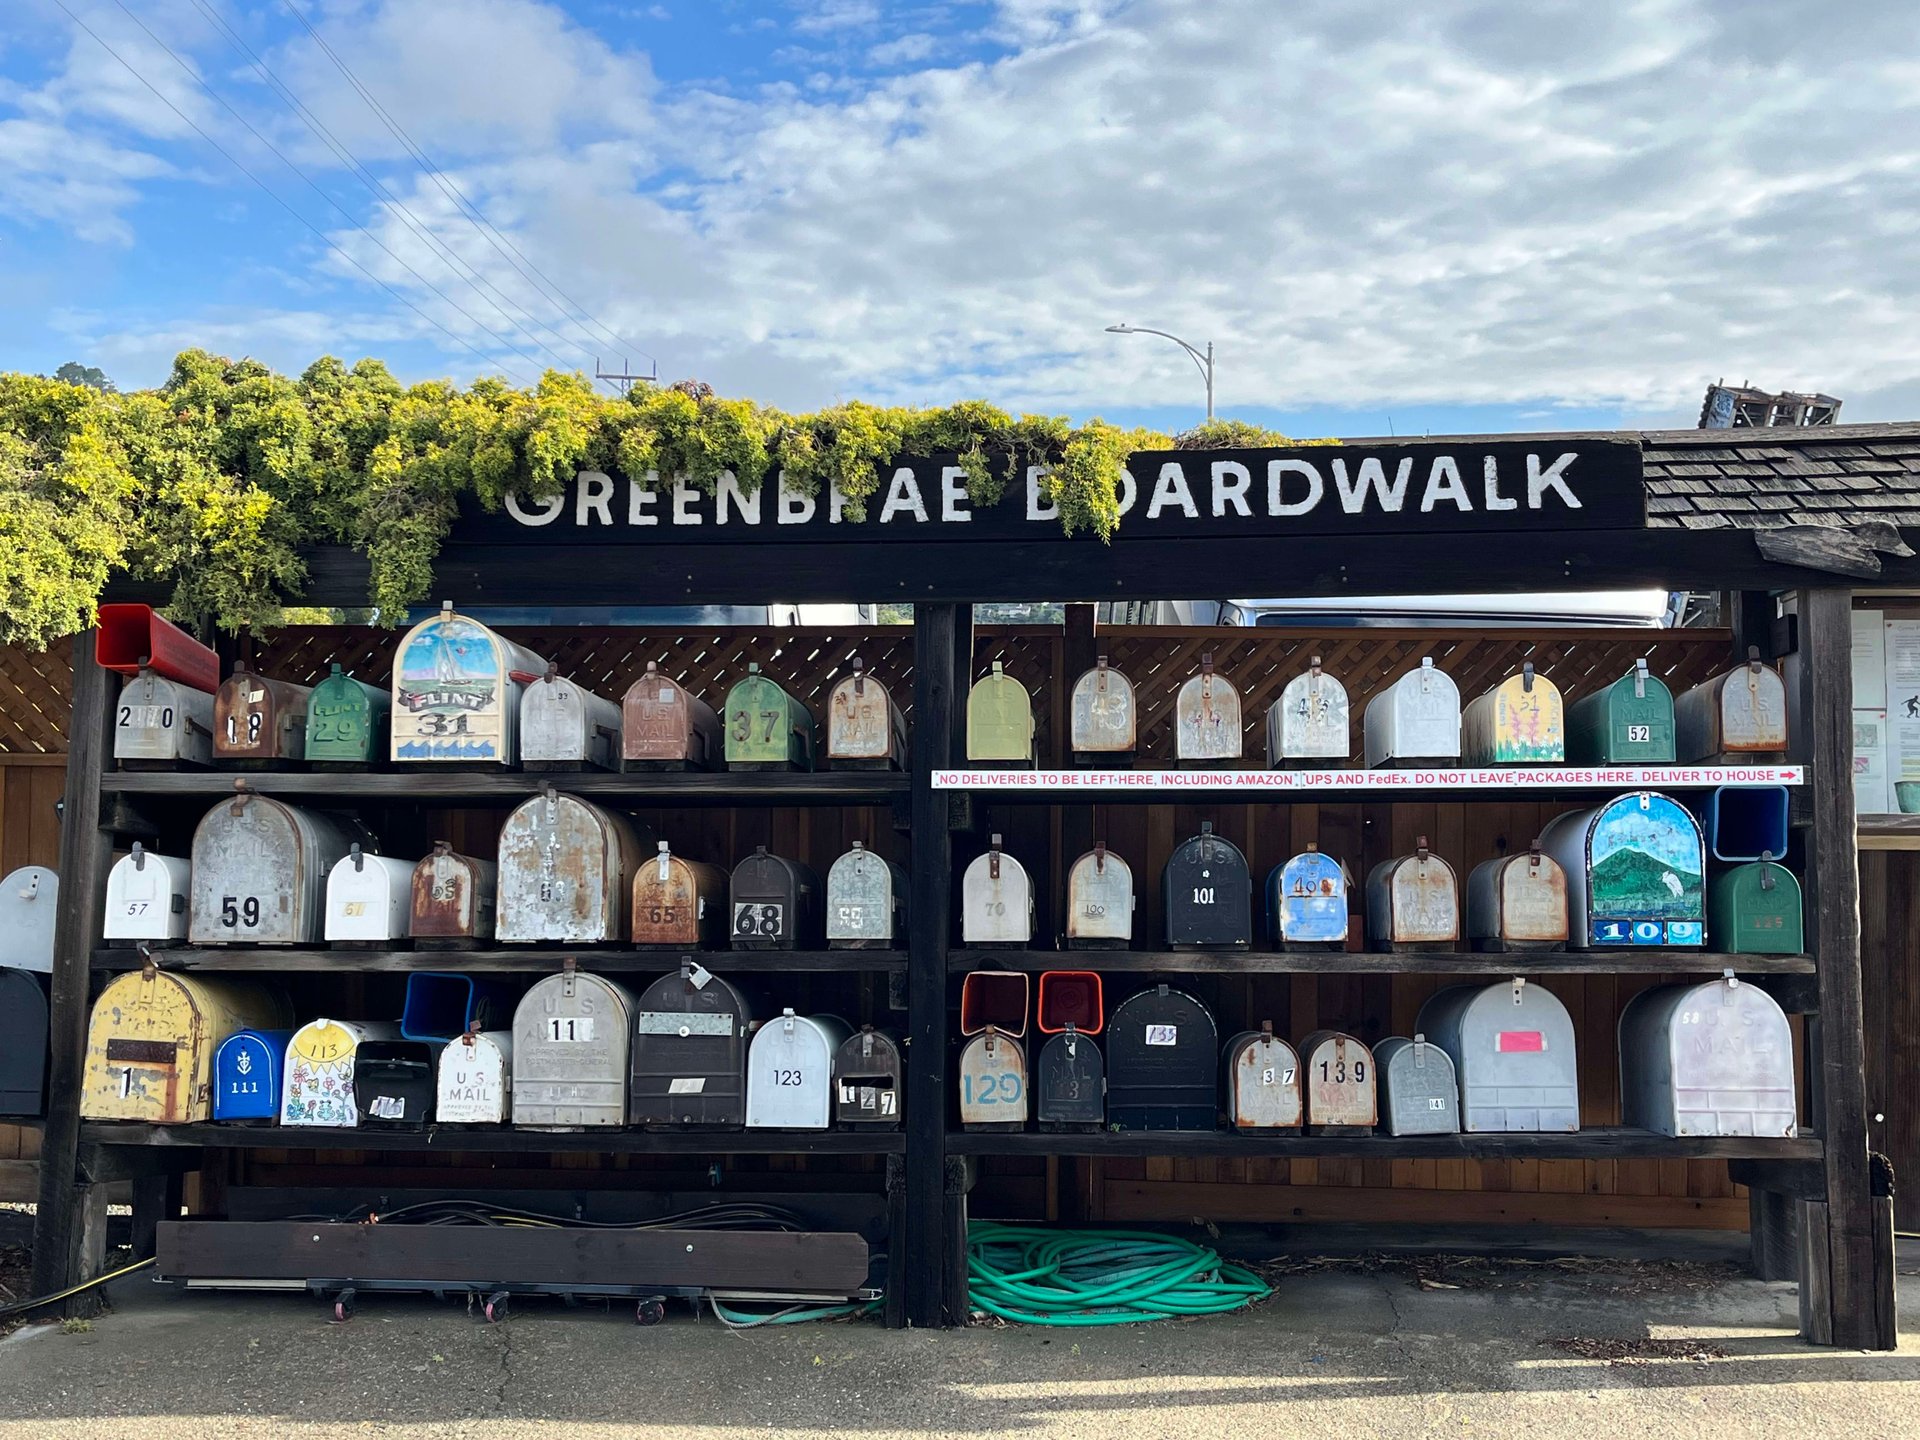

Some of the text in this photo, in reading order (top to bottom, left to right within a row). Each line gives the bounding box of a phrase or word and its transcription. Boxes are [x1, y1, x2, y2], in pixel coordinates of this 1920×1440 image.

[313, 703, 361, 717] FLINT
[414, 693, 483, 709] FLINT
[1619, 708, 1660, 721] MAIL
[313, 720, 356, 743] 29
[414, 713, 476, 737] 31
[732, 709, 780, 743] 37
[1629, 726, 1648, 740] 52
[940, 770, 1775, 787] NO DELIVERIES TO BE LEFT HERE, INCLUDING AMAZON UPS AND FedEx. DO NOT LEAVE PACKAGES HERE. DELIVER TO HOUSE
[1193, 886, 1216, 905] 101
[127, 903, 149, 916] 57
[222, 896, 260, 928] 59
[650, 905, 676, 924] 65
[1085, 903, 1105, 915] 100
[737, 904, 782, 936] 68
[552, 1019, 575, 1041] 11
[310, 1043, 338, 1059] 113
[1693, 1036, 1768, 1055] MAIL
[774, 1069, 802, 1086] 123
[1319, 1060, 1365, 1083] 139
[232, 1082, 258, 1094] 111
[449, 1088, 491, 1101] MAIL
[963, 1073, 1022, 1105] 129
